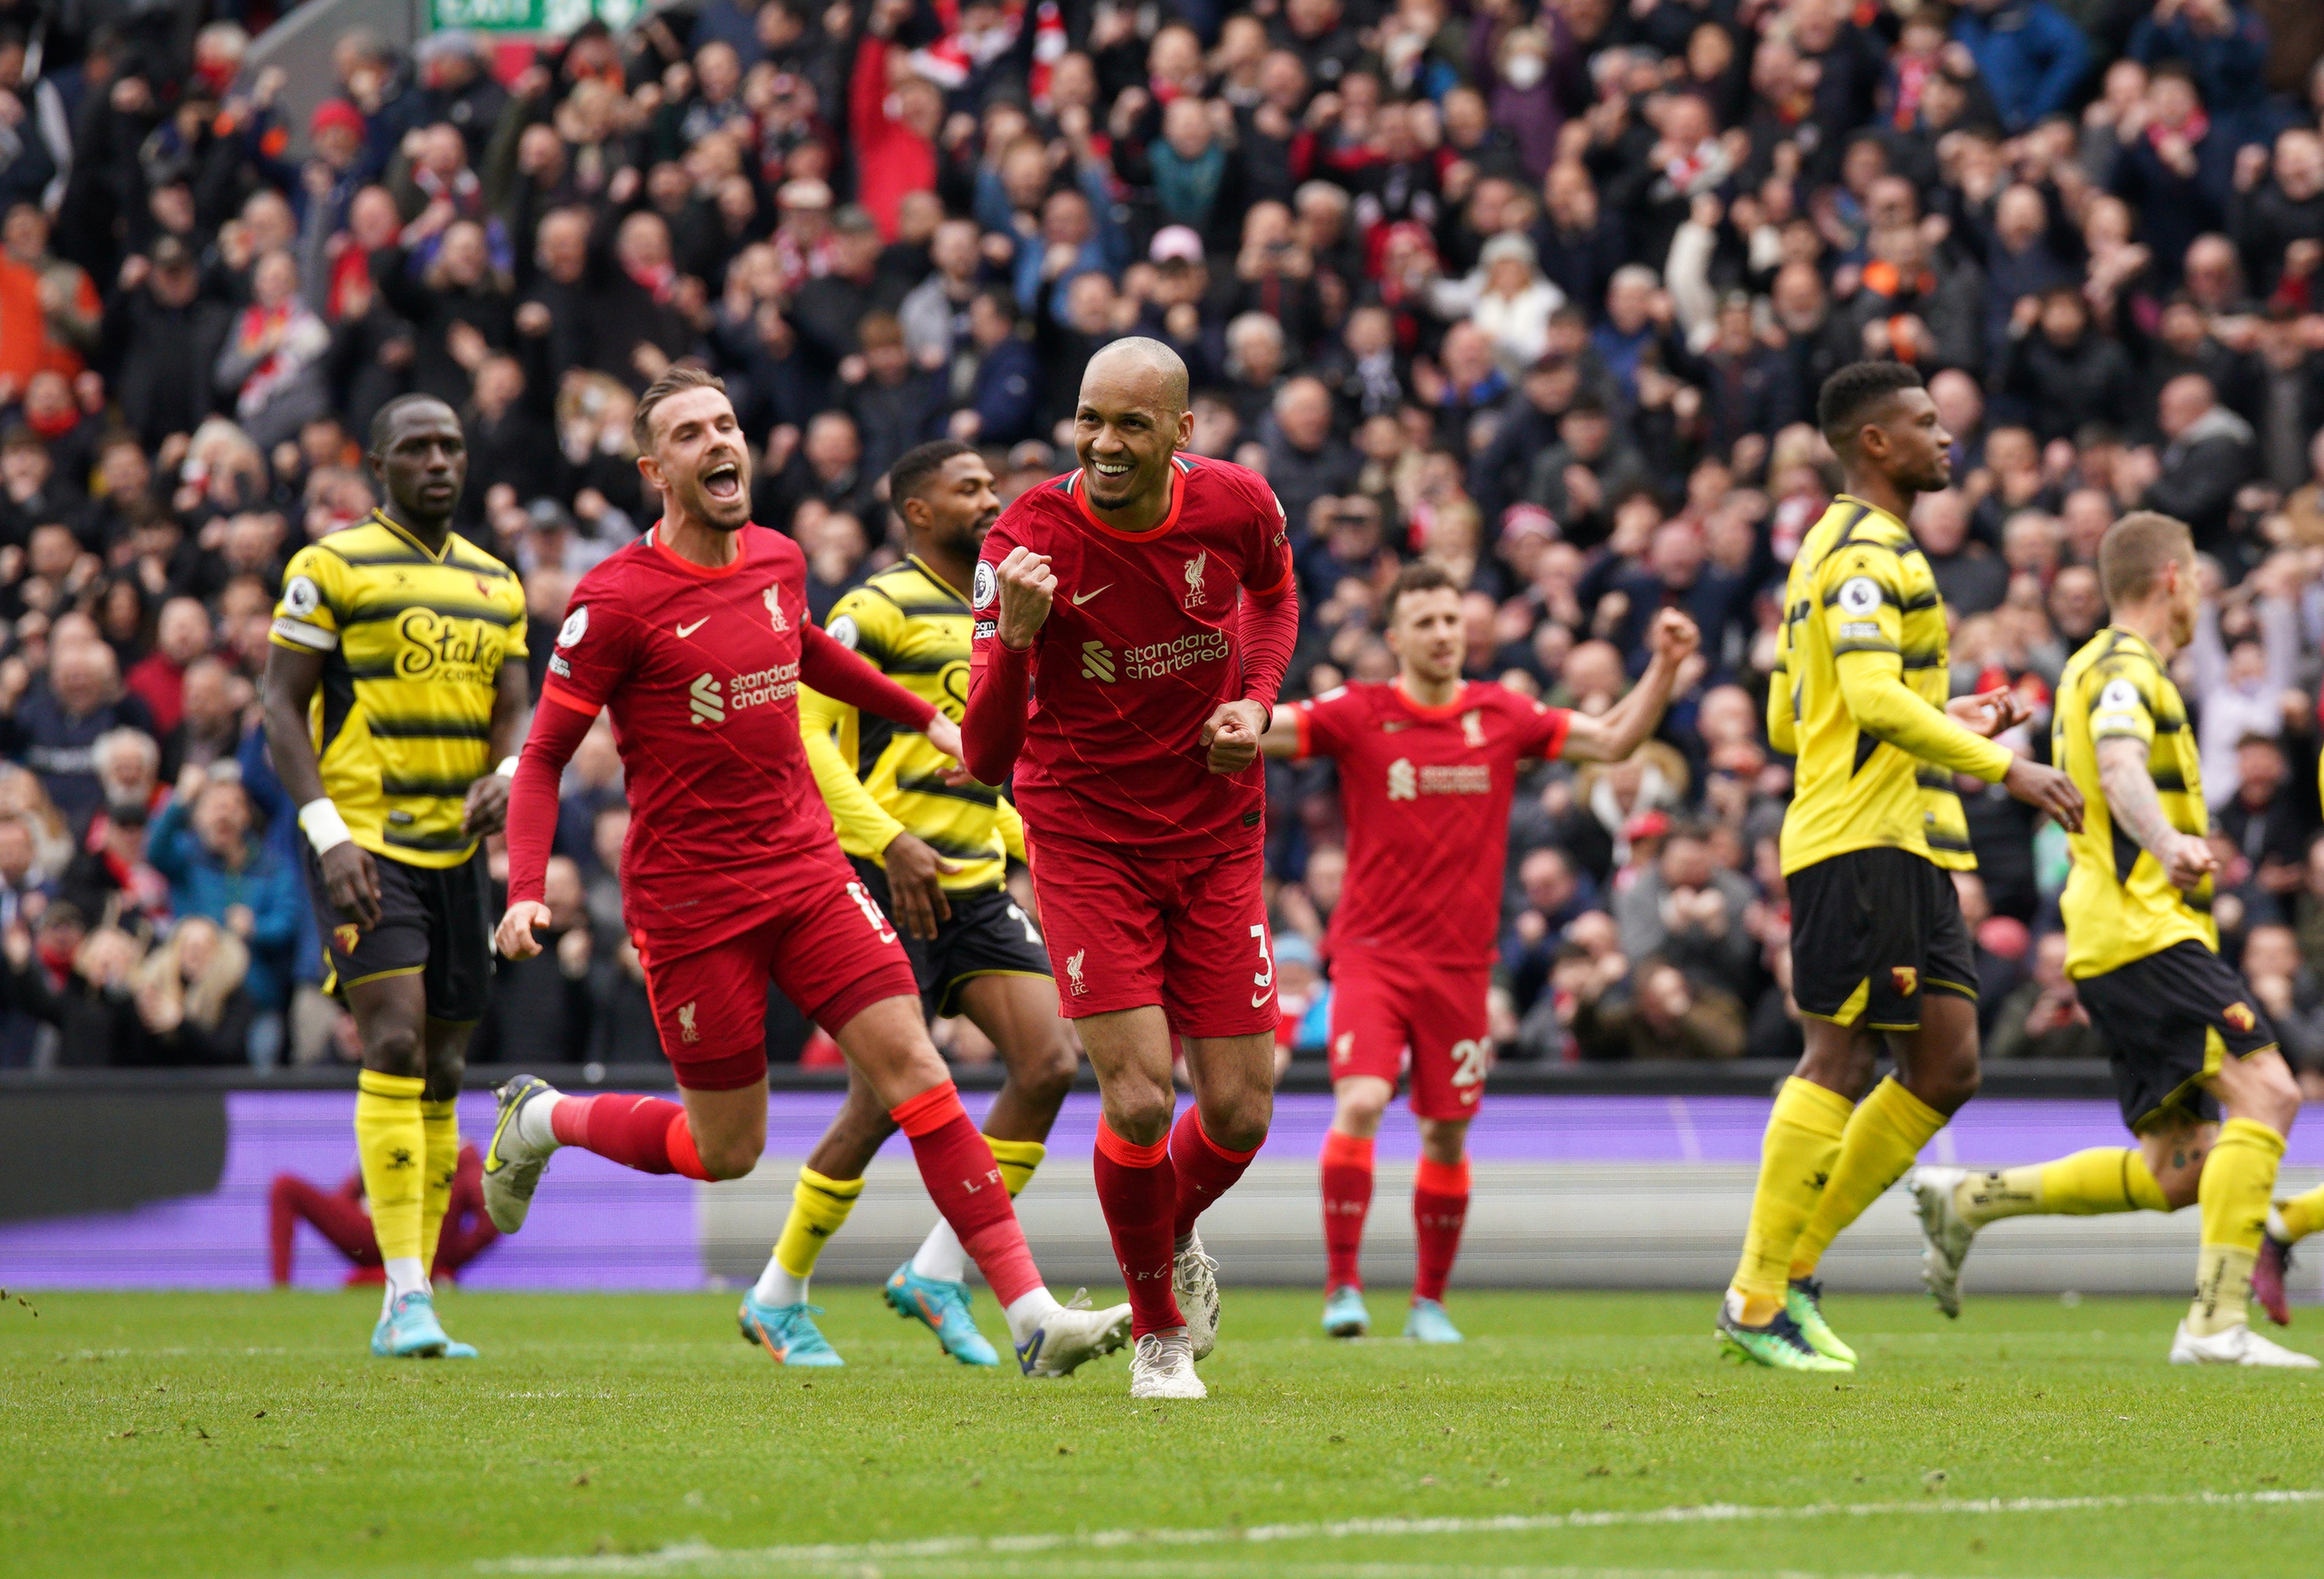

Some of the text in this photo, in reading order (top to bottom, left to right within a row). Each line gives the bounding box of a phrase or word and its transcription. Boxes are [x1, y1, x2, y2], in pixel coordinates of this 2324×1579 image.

[402, 614, 501, 675] Stake
[1124, 627, 1223, 663] standard
[1125, 640, 1229, 680] chartered
[731, 681, 797, 710] chartere
[1250, 924, 1272, 987] 3
